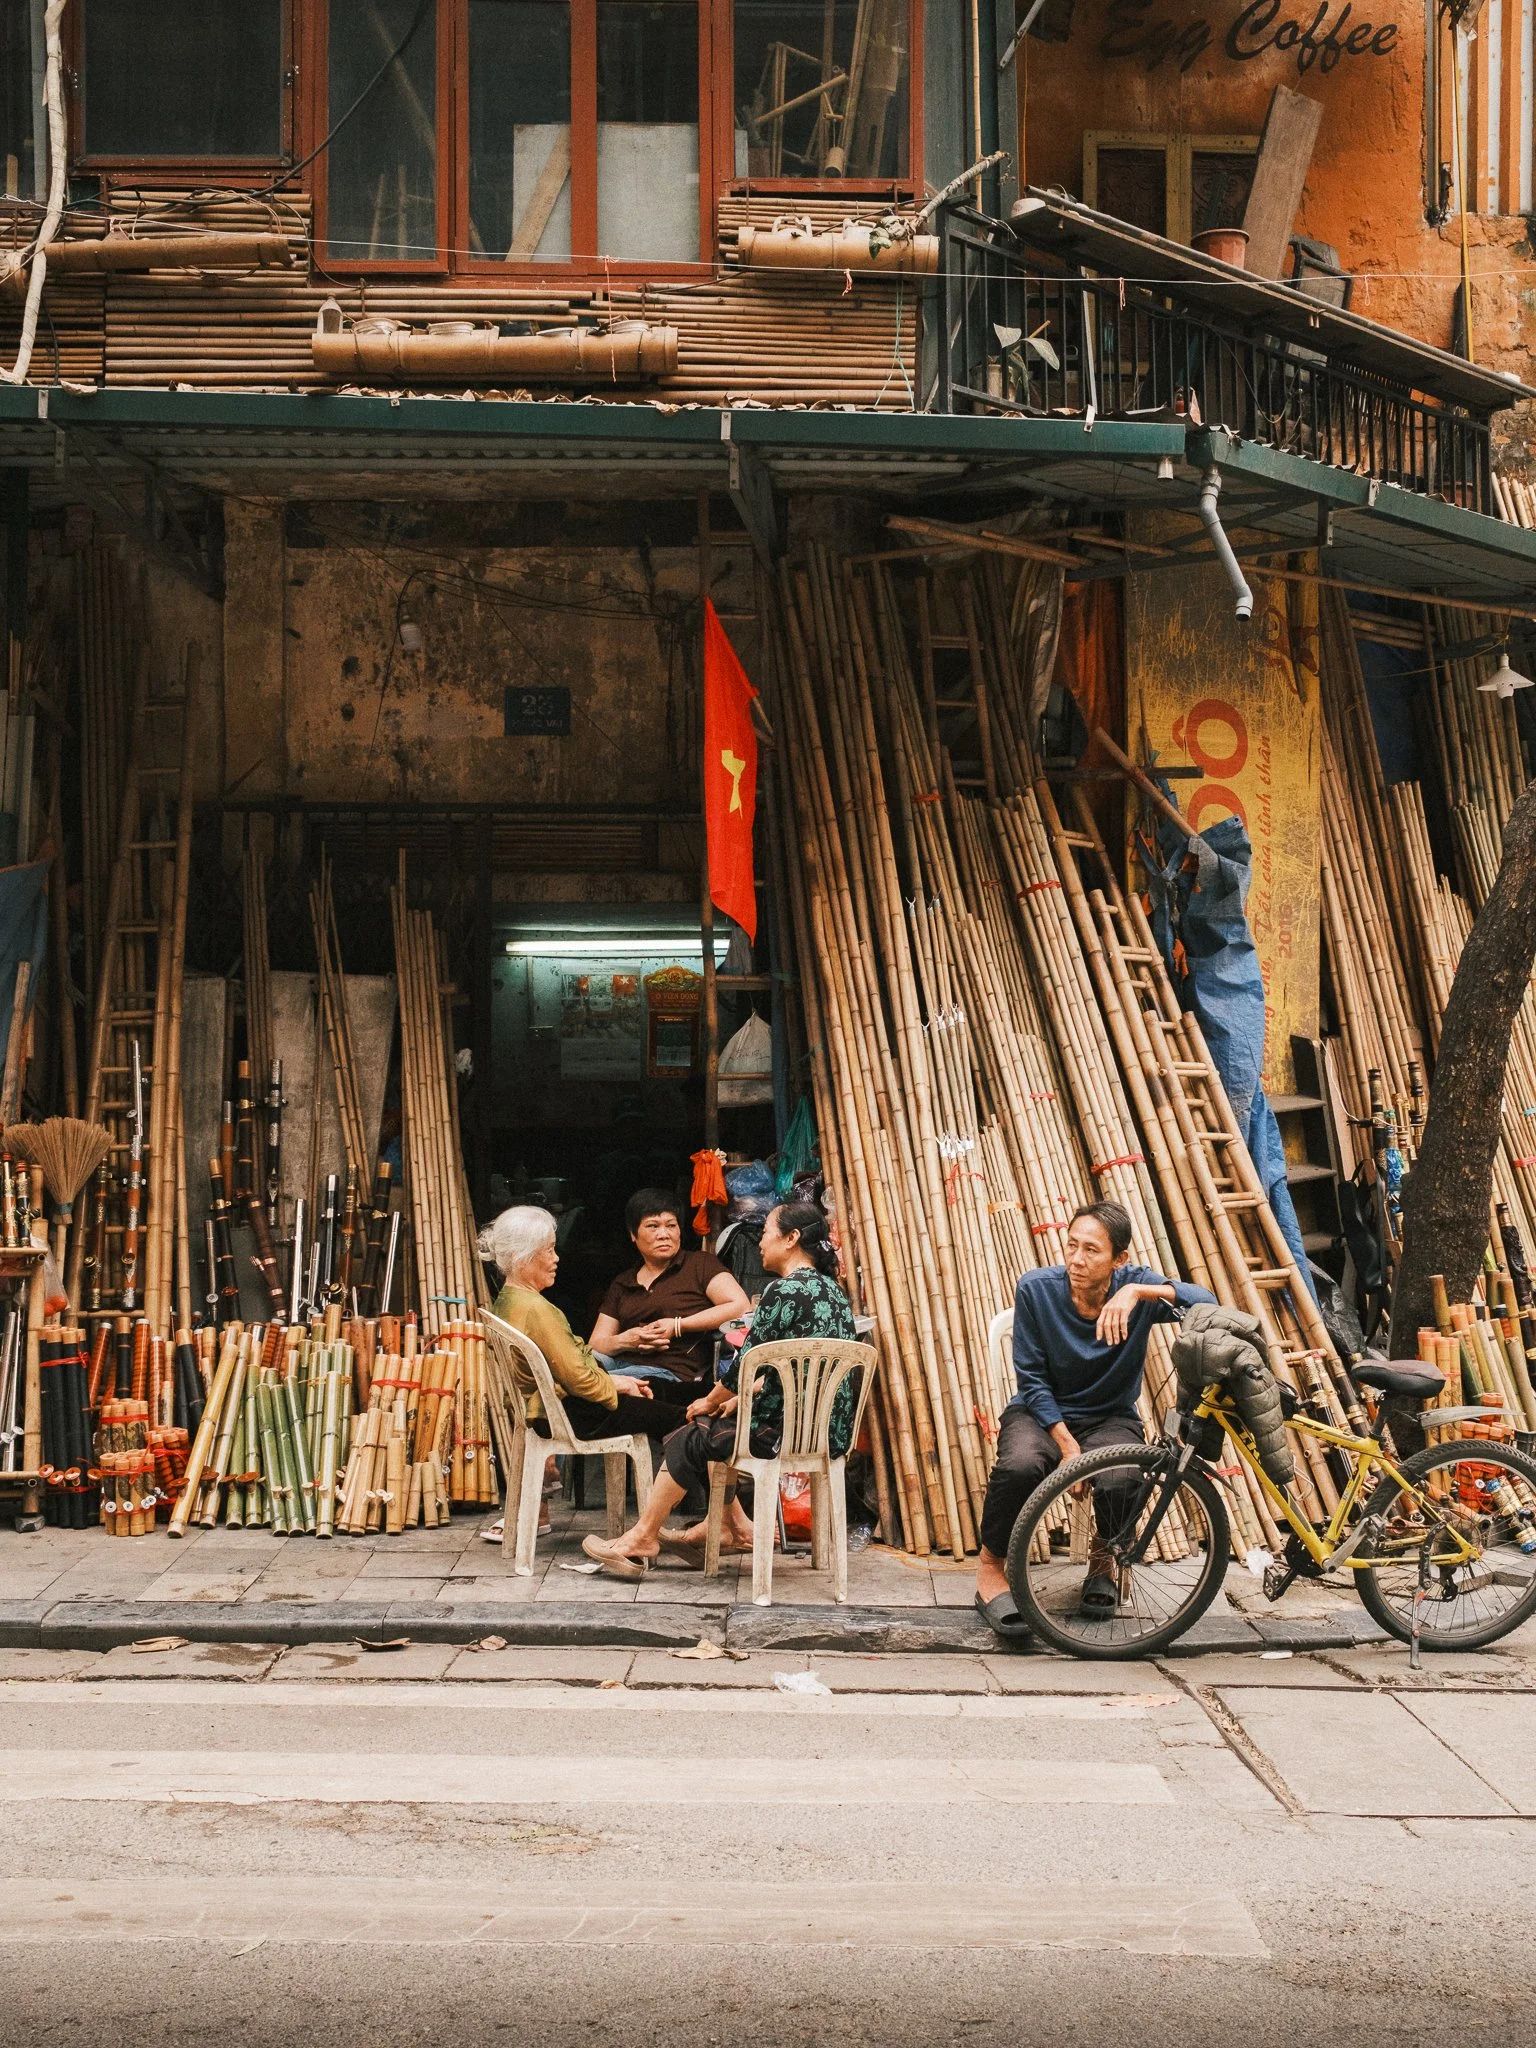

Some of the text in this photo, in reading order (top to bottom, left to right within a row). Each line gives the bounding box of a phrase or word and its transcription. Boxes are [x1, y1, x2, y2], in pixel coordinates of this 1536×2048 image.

[1100, 0, 1398, 75] Egg Coffee
[1255, 735, 1271, 785] thân
[1255, 794, 1271, 837] tình
[1254, 889, 1274, 944] Tết
[1277, 904, 1293, 959] 2016
